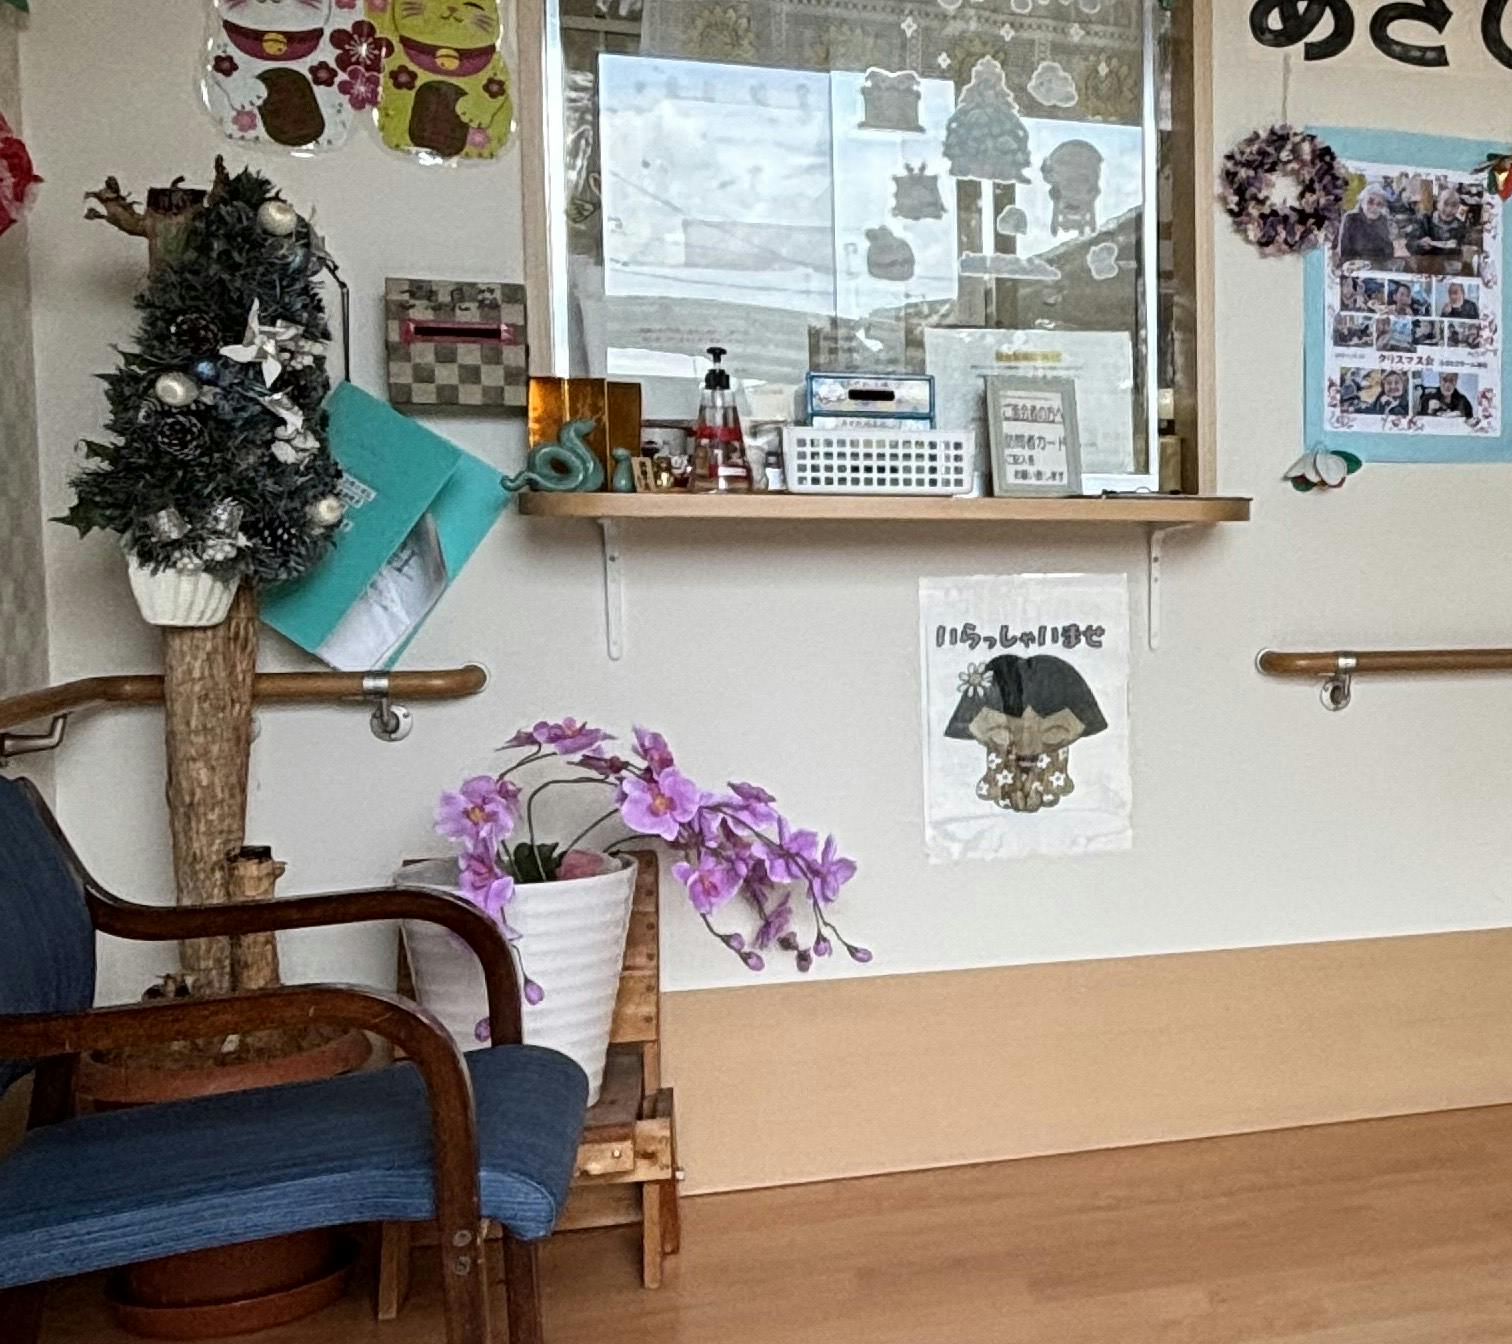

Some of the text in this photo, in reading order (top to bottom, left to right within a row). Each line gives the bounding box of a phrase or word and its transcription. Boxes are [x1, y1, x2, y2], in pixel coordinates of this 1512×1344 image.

[1378, 354, 1434, 367] クリスマス会
[936, 623, 1105, 649] いらっしゃいませ
